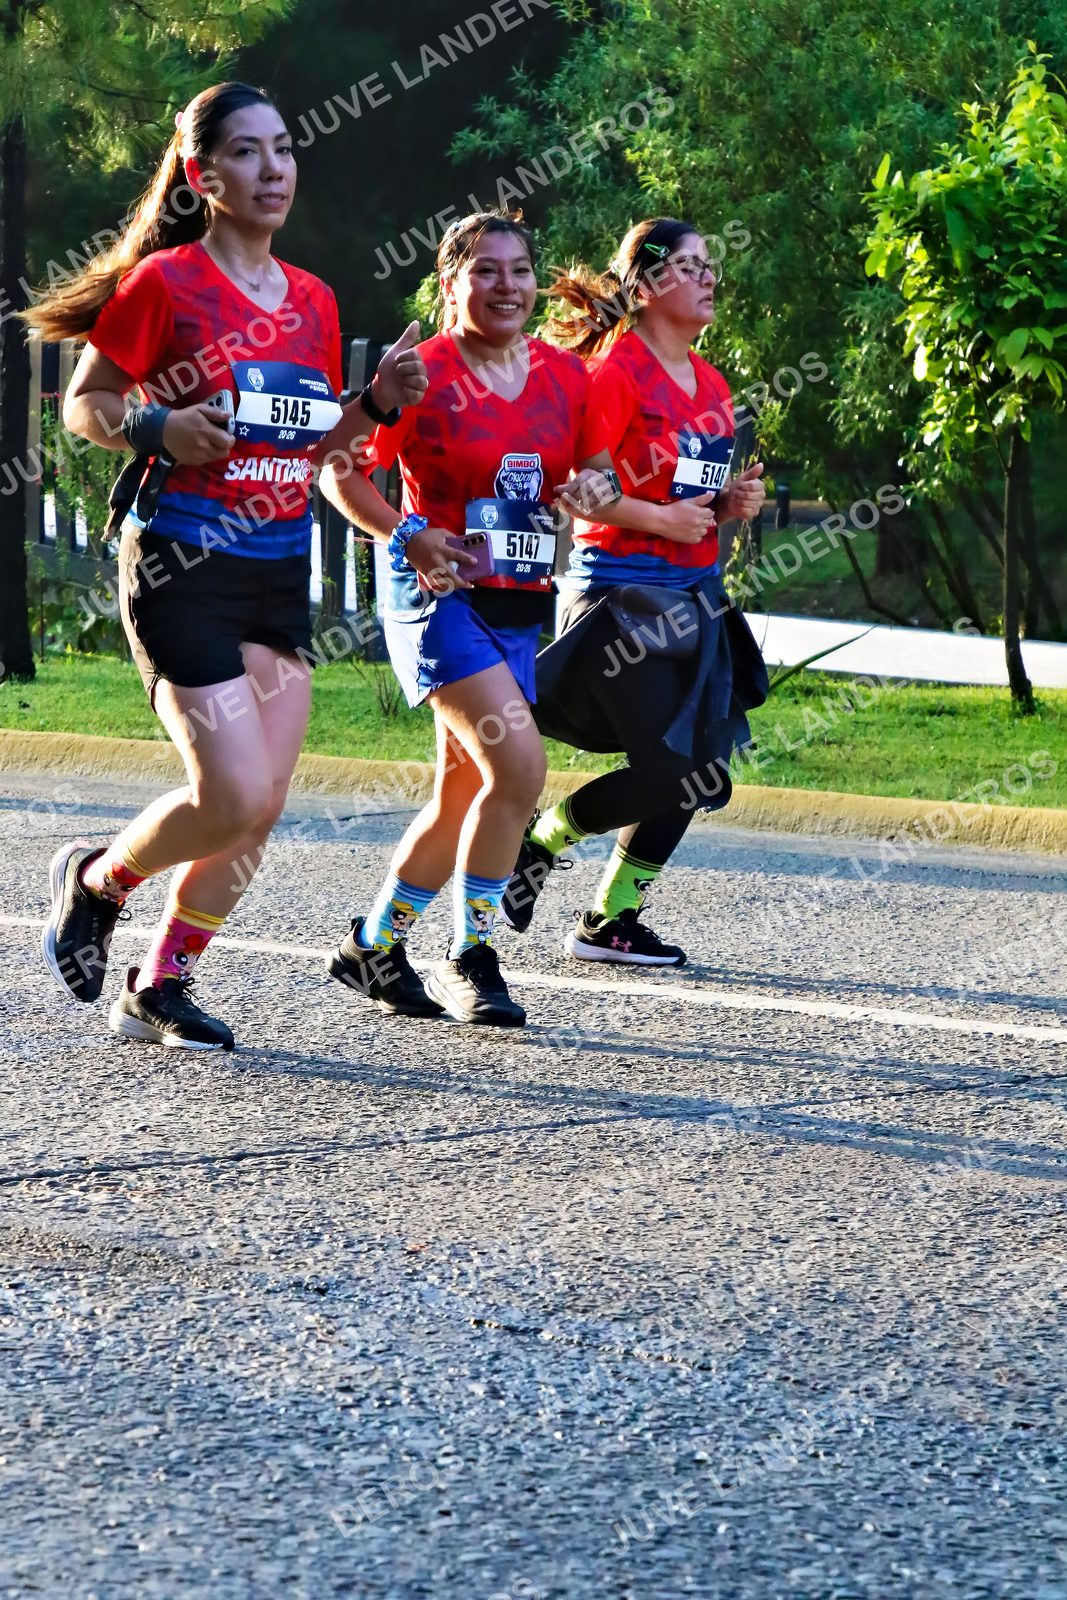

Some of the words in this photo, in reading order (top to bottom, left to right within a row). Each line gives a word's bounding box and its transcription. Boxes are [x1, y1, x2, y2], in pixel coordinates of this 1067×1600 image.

[270, 397, 311, 427] 5145
[507, 460, 535, 468] BIMBO
[506, 532, 541, 560] 5147
